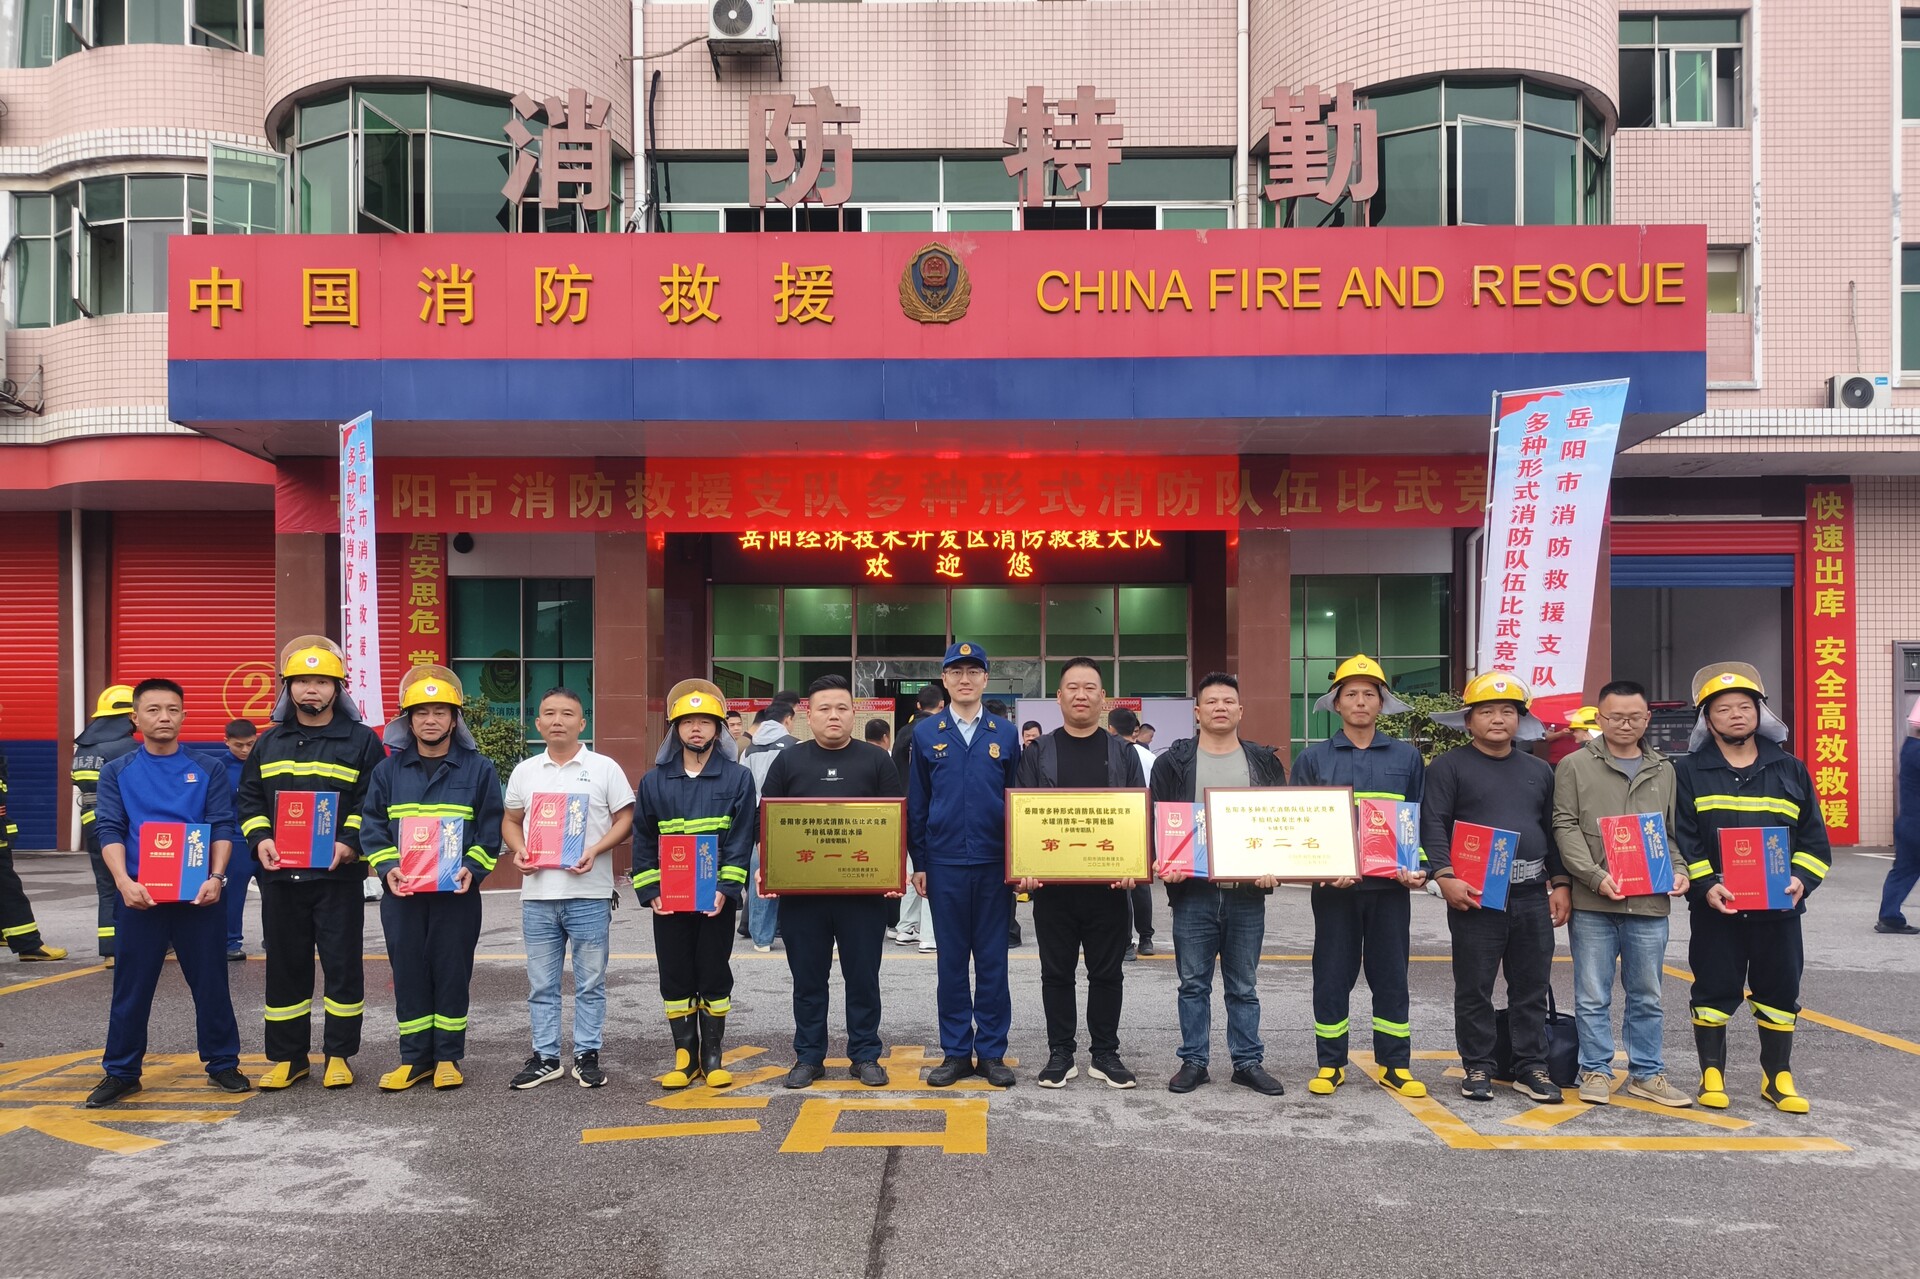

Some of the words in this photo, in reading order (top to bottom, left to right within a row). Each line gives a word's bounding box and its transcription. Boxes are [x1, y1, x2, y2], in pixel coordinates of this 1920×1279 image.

[502, 83, 1380, 212] 消防特勤
[187, 260, 836, 330] 中国消防救援
[1036, 268, 1193, 314] CHINA
[1208, 266, 1323, 311] FIRE
[1337, 264, 1446, 309] AND
[1471, 261, 1687, 308] RESCUE
[865, 551, 1034, 578] 欢迎您
[1531, 406, 1594, 687] 岳阳市消防救援支队
[1811, 491, 1846, 619] 快速出库
[1813, 635, 1850, 829] 安全高效救援
[795, 849, 870, 863] 第一名
[1041, 838, 1115, 852] 第一名
[1244, 837, 1321, 850] 第二名
